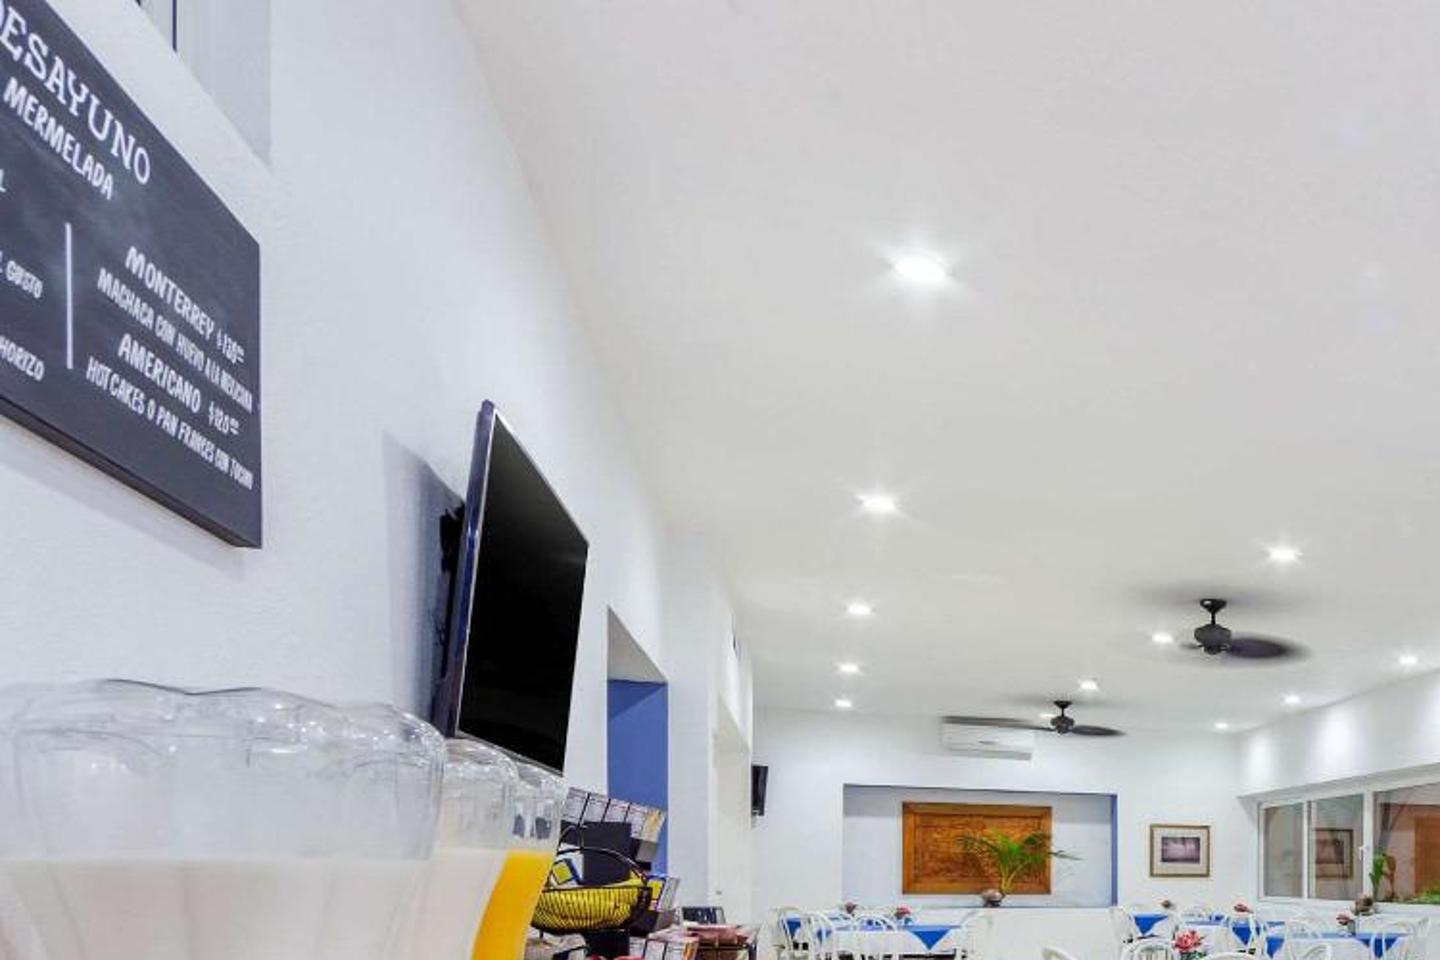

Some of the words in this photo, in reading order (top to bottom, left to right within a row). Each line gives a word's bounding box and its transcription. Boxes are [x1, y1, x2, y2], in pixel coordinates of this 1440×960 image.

[0, 0, 151, 185] ESAYUNO
[3, 76, 114, 201] MERMELADA
[97, 267, 155, 331] MACHACA
[125, 246, 215, 341] MONTERREY
[86, 355, 112, 391] HOT
[109, 373, 146, 415] CAKES
[155, 405, 180, 438] PAN
[117, 332, 201, 414] AMERICANO
